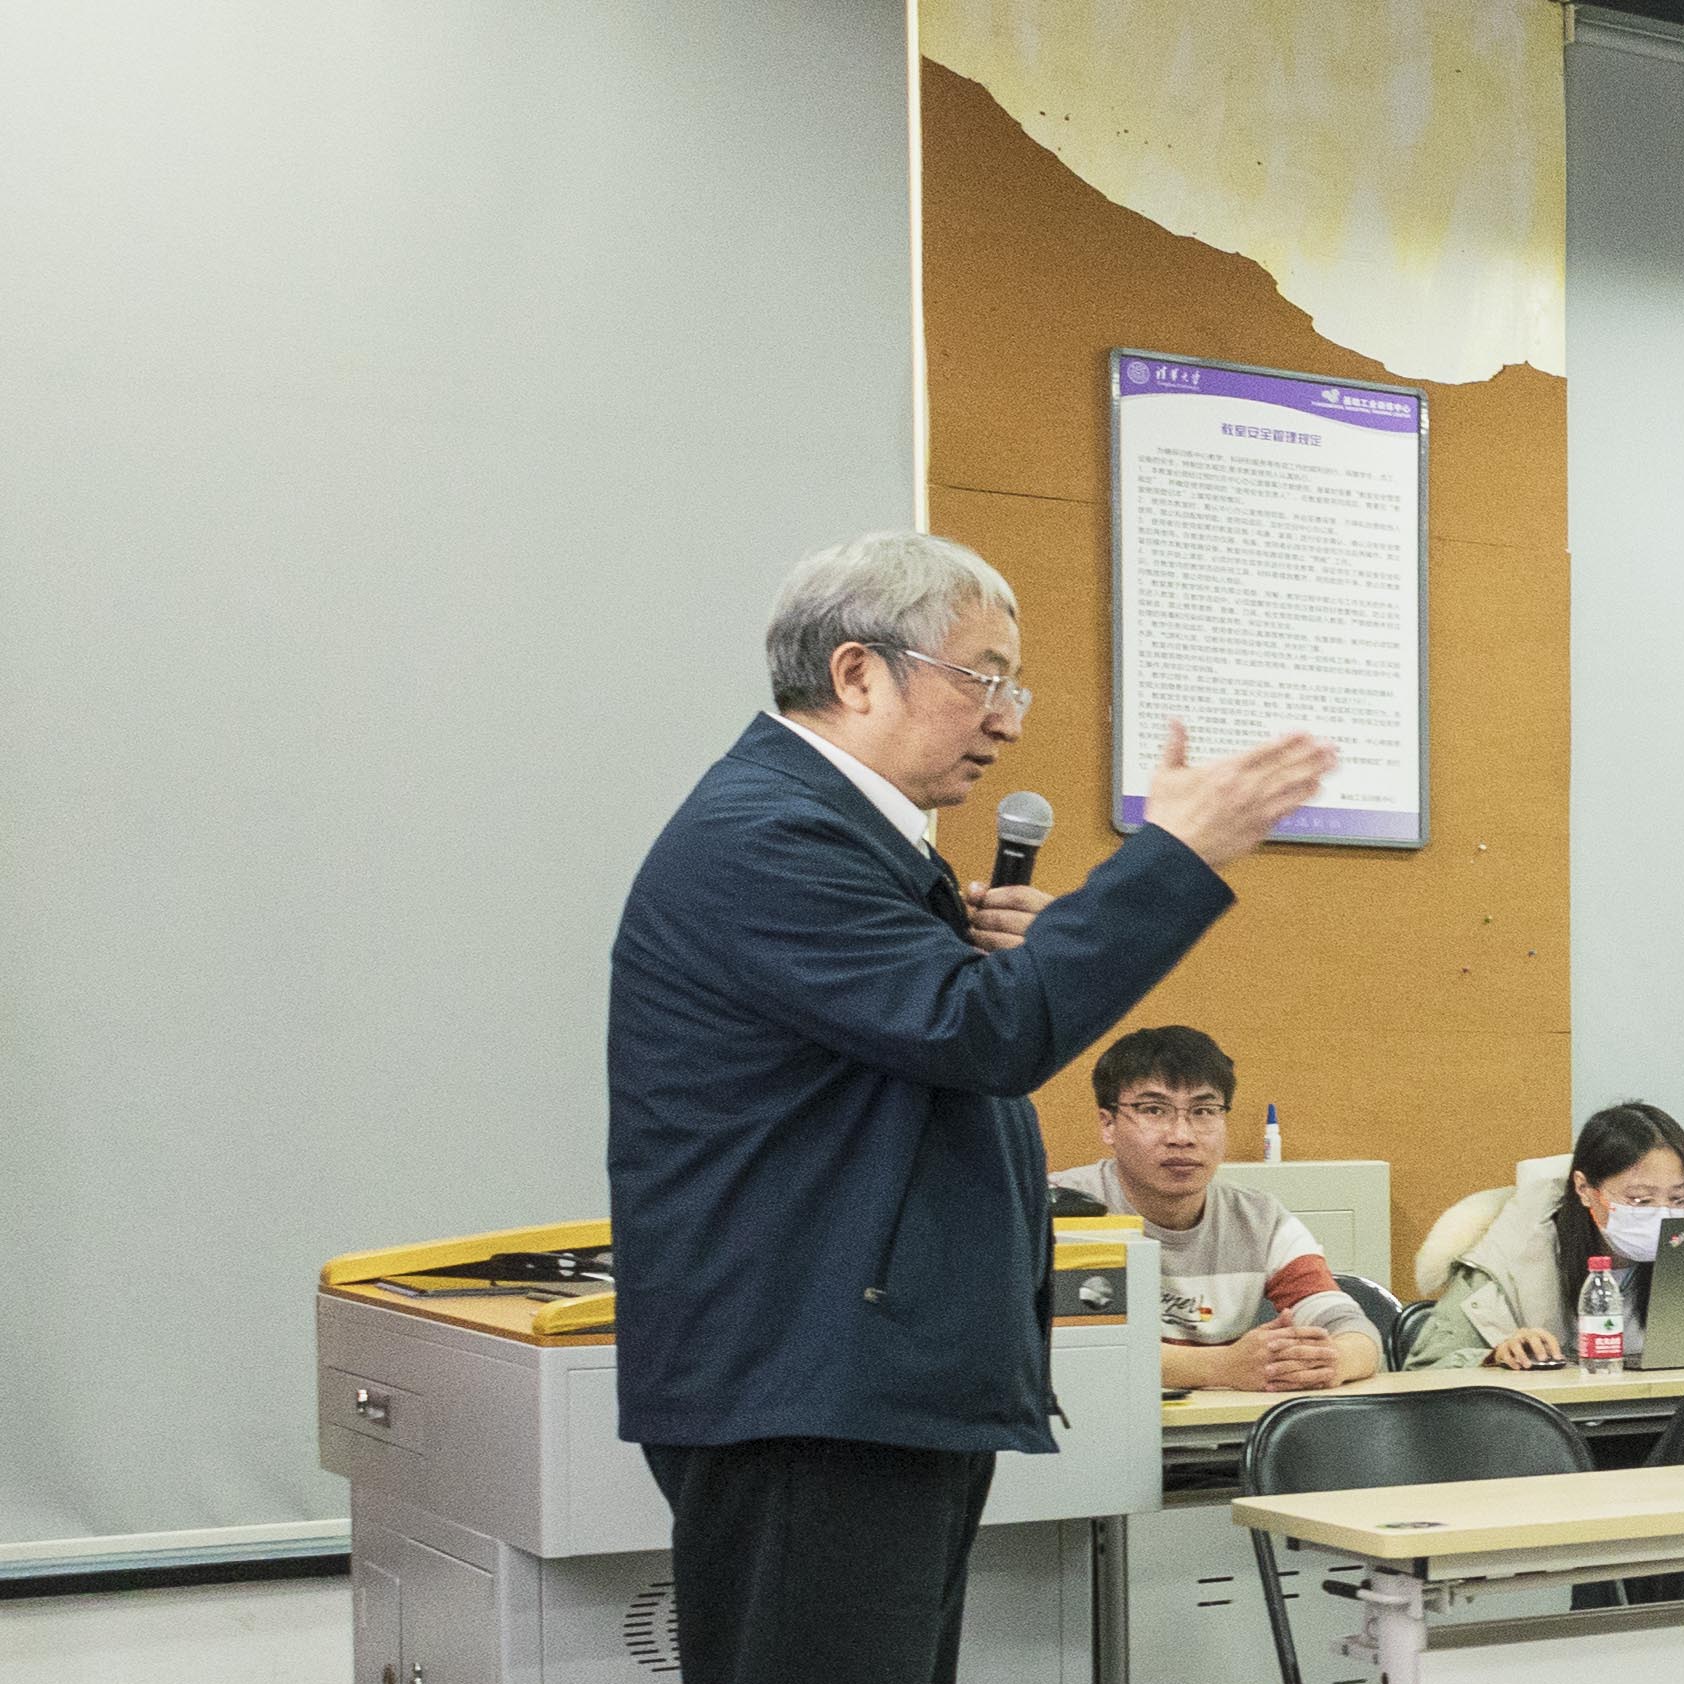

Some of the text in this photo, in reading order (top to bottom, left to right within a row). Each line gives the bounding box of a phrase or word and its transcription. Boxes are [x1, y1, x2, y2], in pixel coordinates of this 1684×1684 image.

[1221, 422, 1322, 447] 教室安全管理规定
